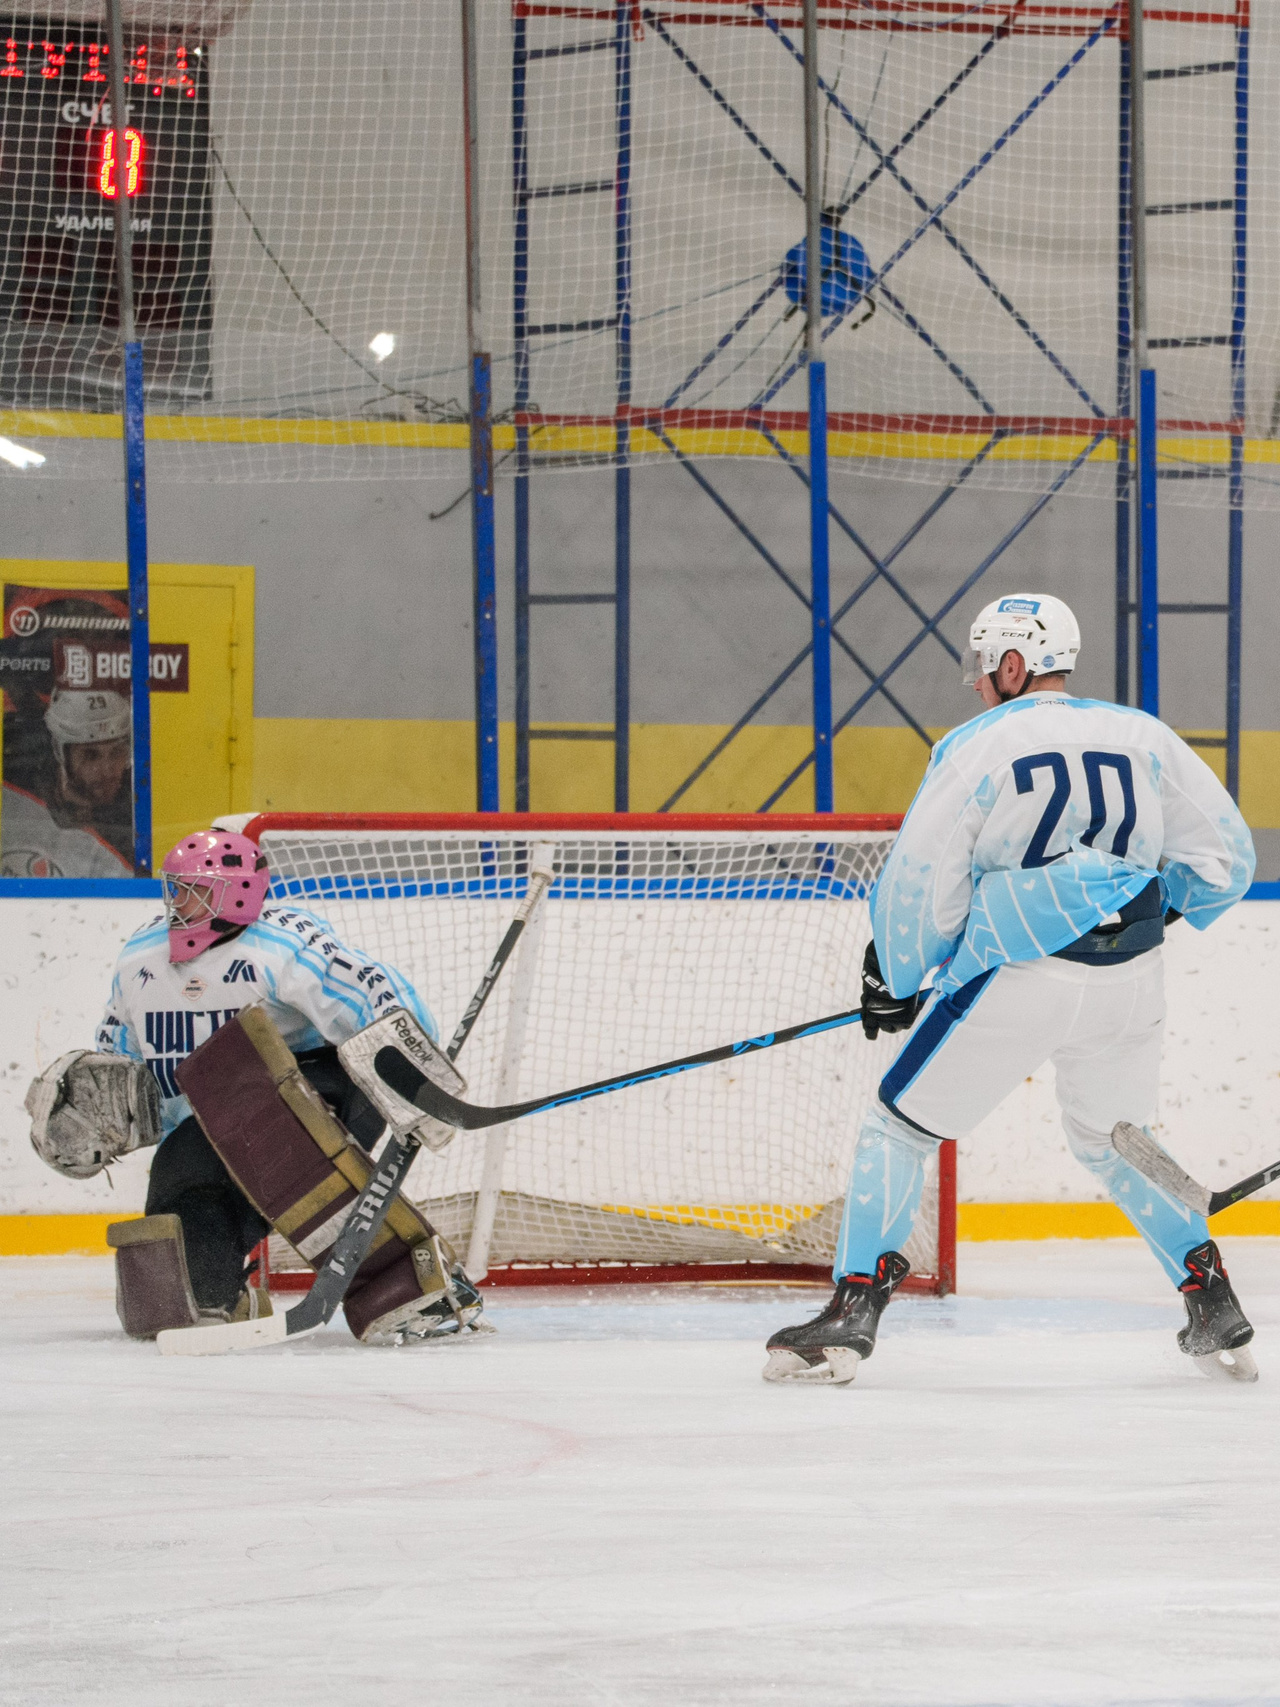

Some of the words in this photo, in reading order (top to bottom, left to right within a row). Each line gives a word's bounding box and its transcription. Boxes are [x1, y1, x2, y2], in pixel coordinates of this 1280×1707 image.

[55, 215, 152, 232] УДАЛЕИЯ
[97, 653, 131, 678] BIG
[149, 654, 182, 679] OY
[1011, 751, 1137, 869] 20
[145, 1007, 240, 1054] ЧИСТ
[390, 1016, 434, 1065] Reebok
